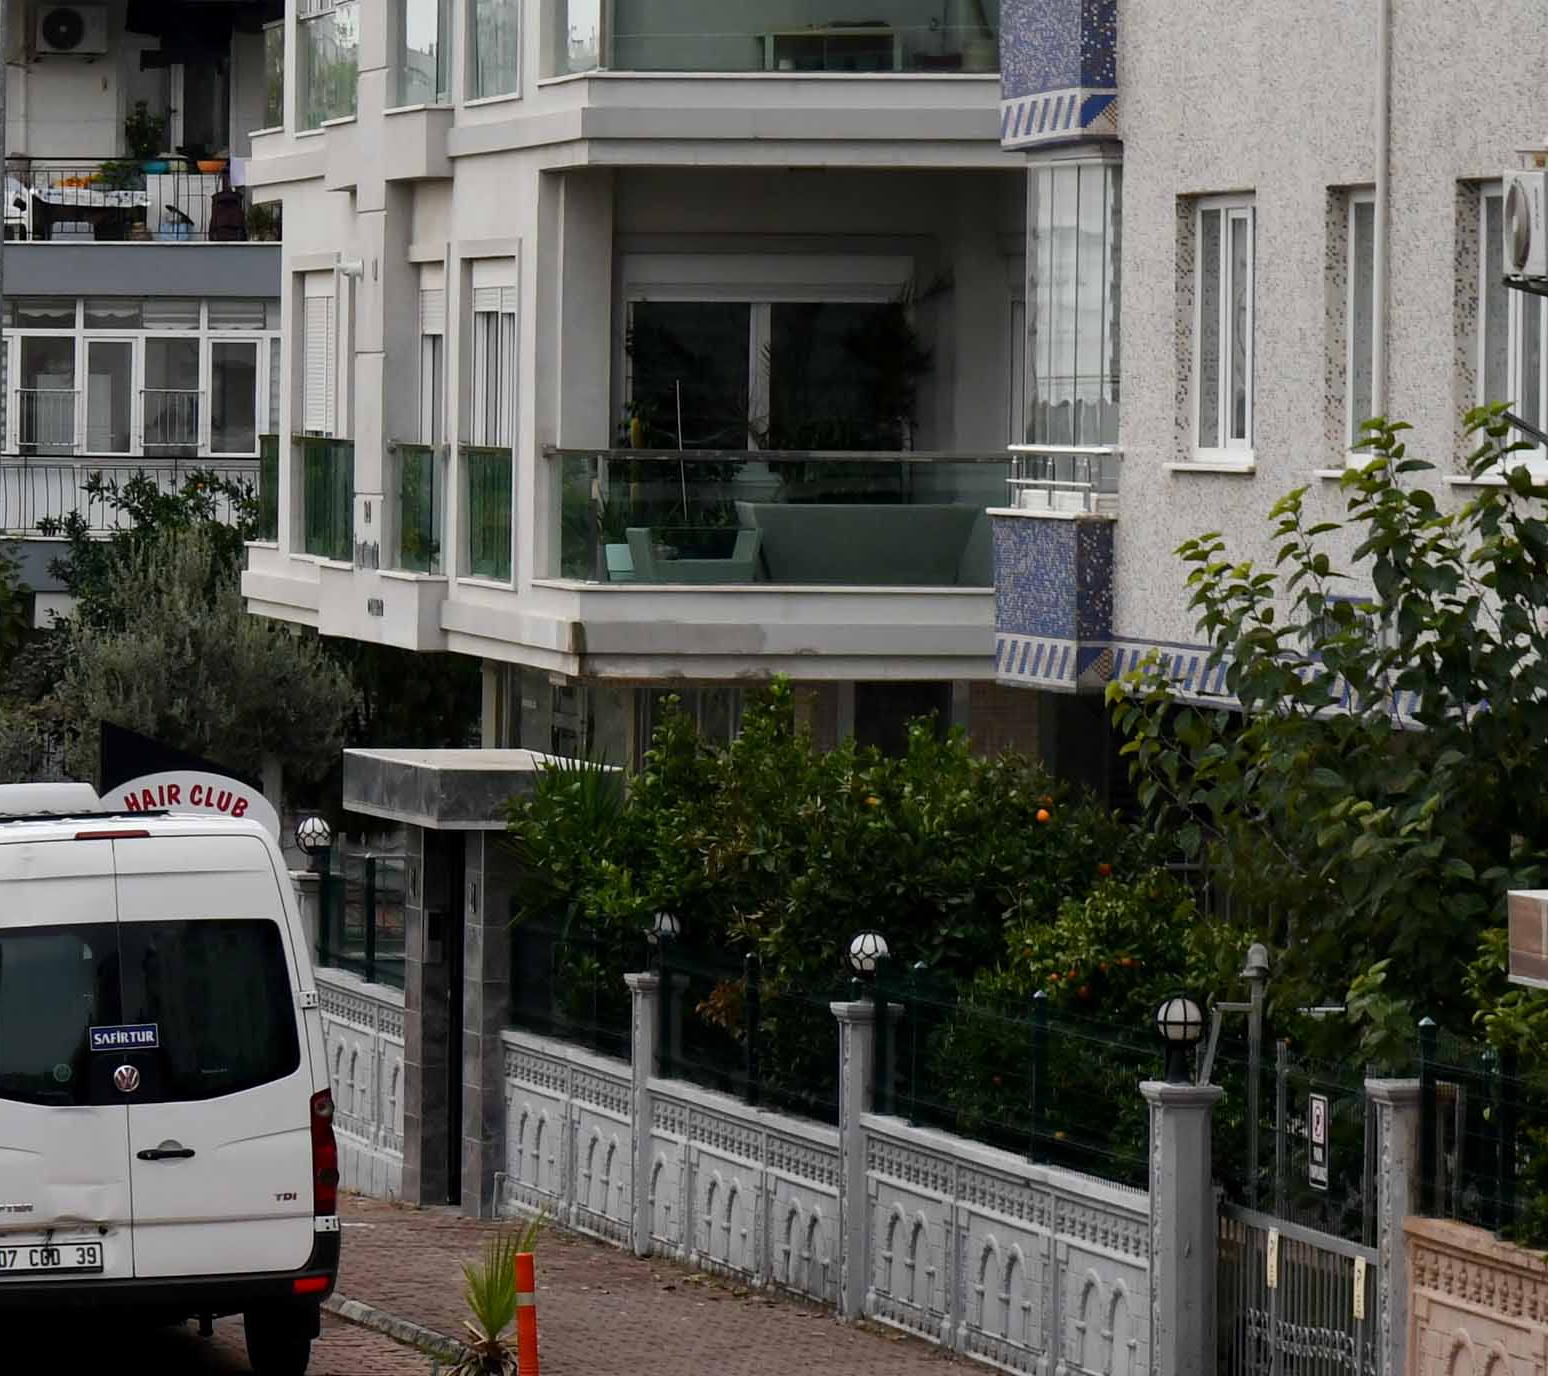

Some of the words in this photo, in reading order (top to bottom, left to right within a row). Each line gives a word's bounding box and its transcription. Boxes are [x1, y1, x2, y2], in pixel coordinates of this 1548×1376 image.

[123, 784, 181, 812] HAIR
[189, 784, 249, 818] CLUB
[274, 1192, 298, 1202] TDI
[75, 1246, 98, 1265] 39
